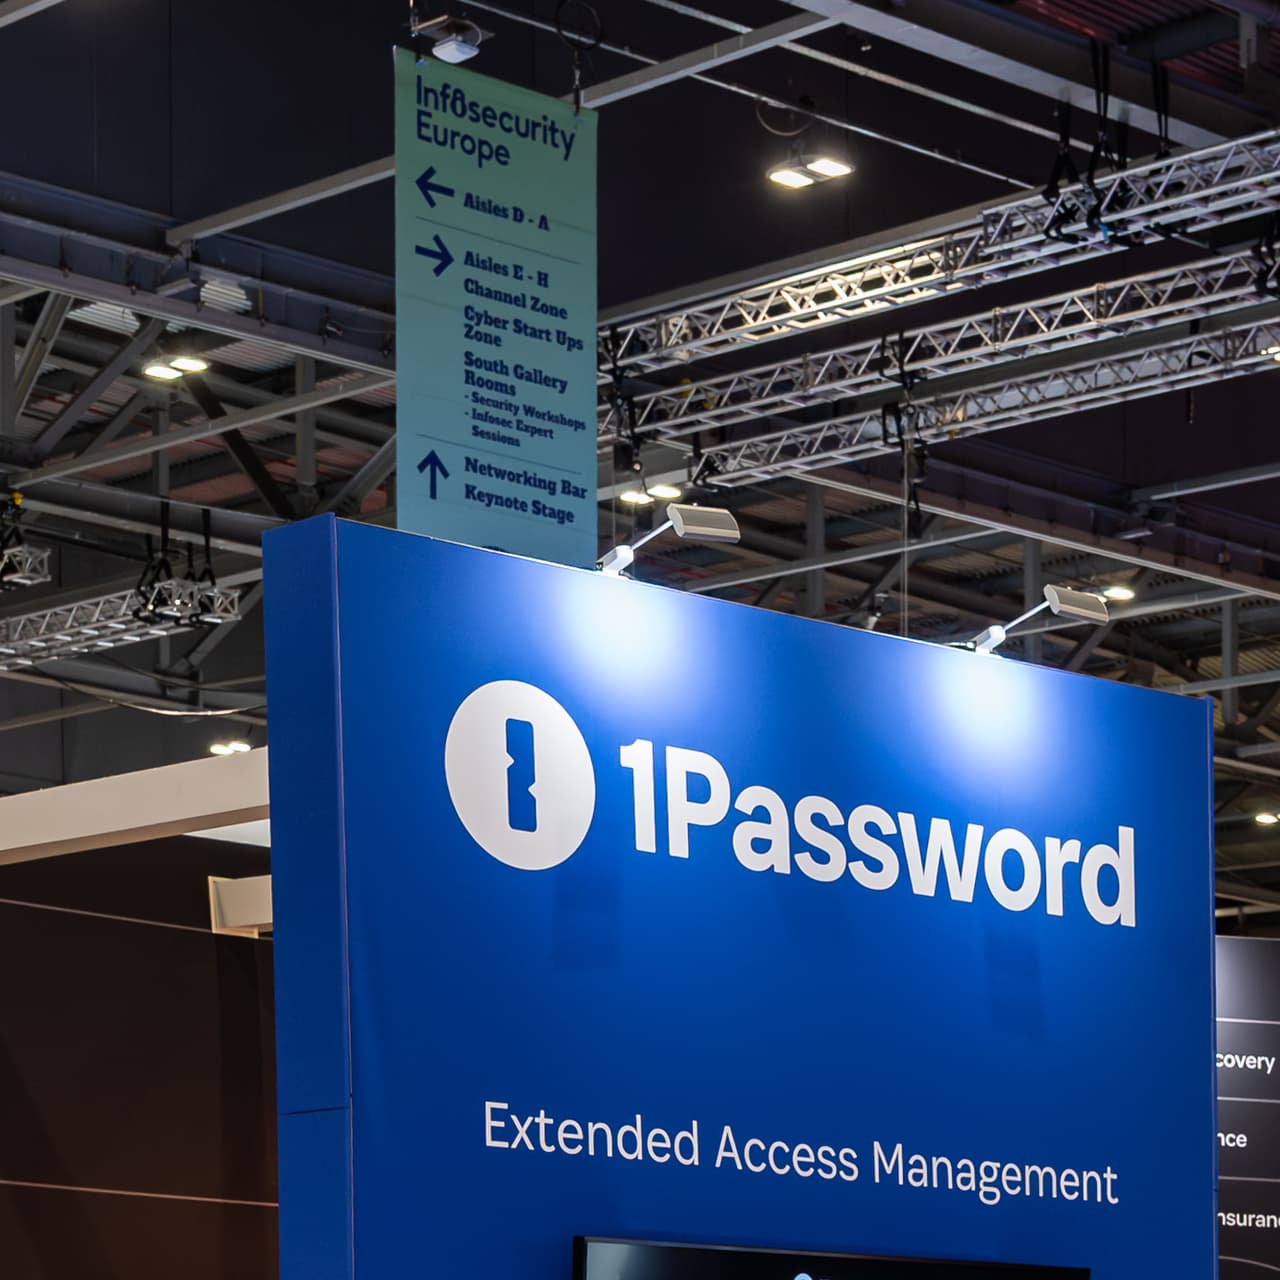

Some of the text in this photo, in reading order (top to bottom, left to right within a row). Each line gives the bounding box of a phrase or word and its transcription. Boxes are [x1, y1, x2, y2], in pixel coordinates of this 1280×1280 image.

[417, 75, 575, 161] Infosecurity
[417, 108, 510, 168] Europe
[464, 192, 508, 221] Aisles
[512, 206, 524, 224] D
[537, 214, 550, 231] A
[464, 251, 508, 279] Aisles
[512, 263, 524, 282] E
[537, 271, 549, 288] H
[464, 279, 568, 320] Channel Zone
[464, 306, 584, 352] Cyber Start Ups
[464, 324, 502, 349] Zone
[464, 351, 568, 394] South Gallery
[464, 370, 516, 398] Rooms
[471, 392, 519, 417] Security
[522, 402, 586, 432] Workshops
[472, 409, 513, 431] Infosec
[516, 418, 554, 441] Expert
[472, 425, 520, 449] Sessions
[464, 457, 587, 500] Networking Bar
[464, 484, 574, 525] Keynote Stage
[620, 738, 1137, 928] 1Password
[483, 1100, 1119, 1207] Extended Access Management
